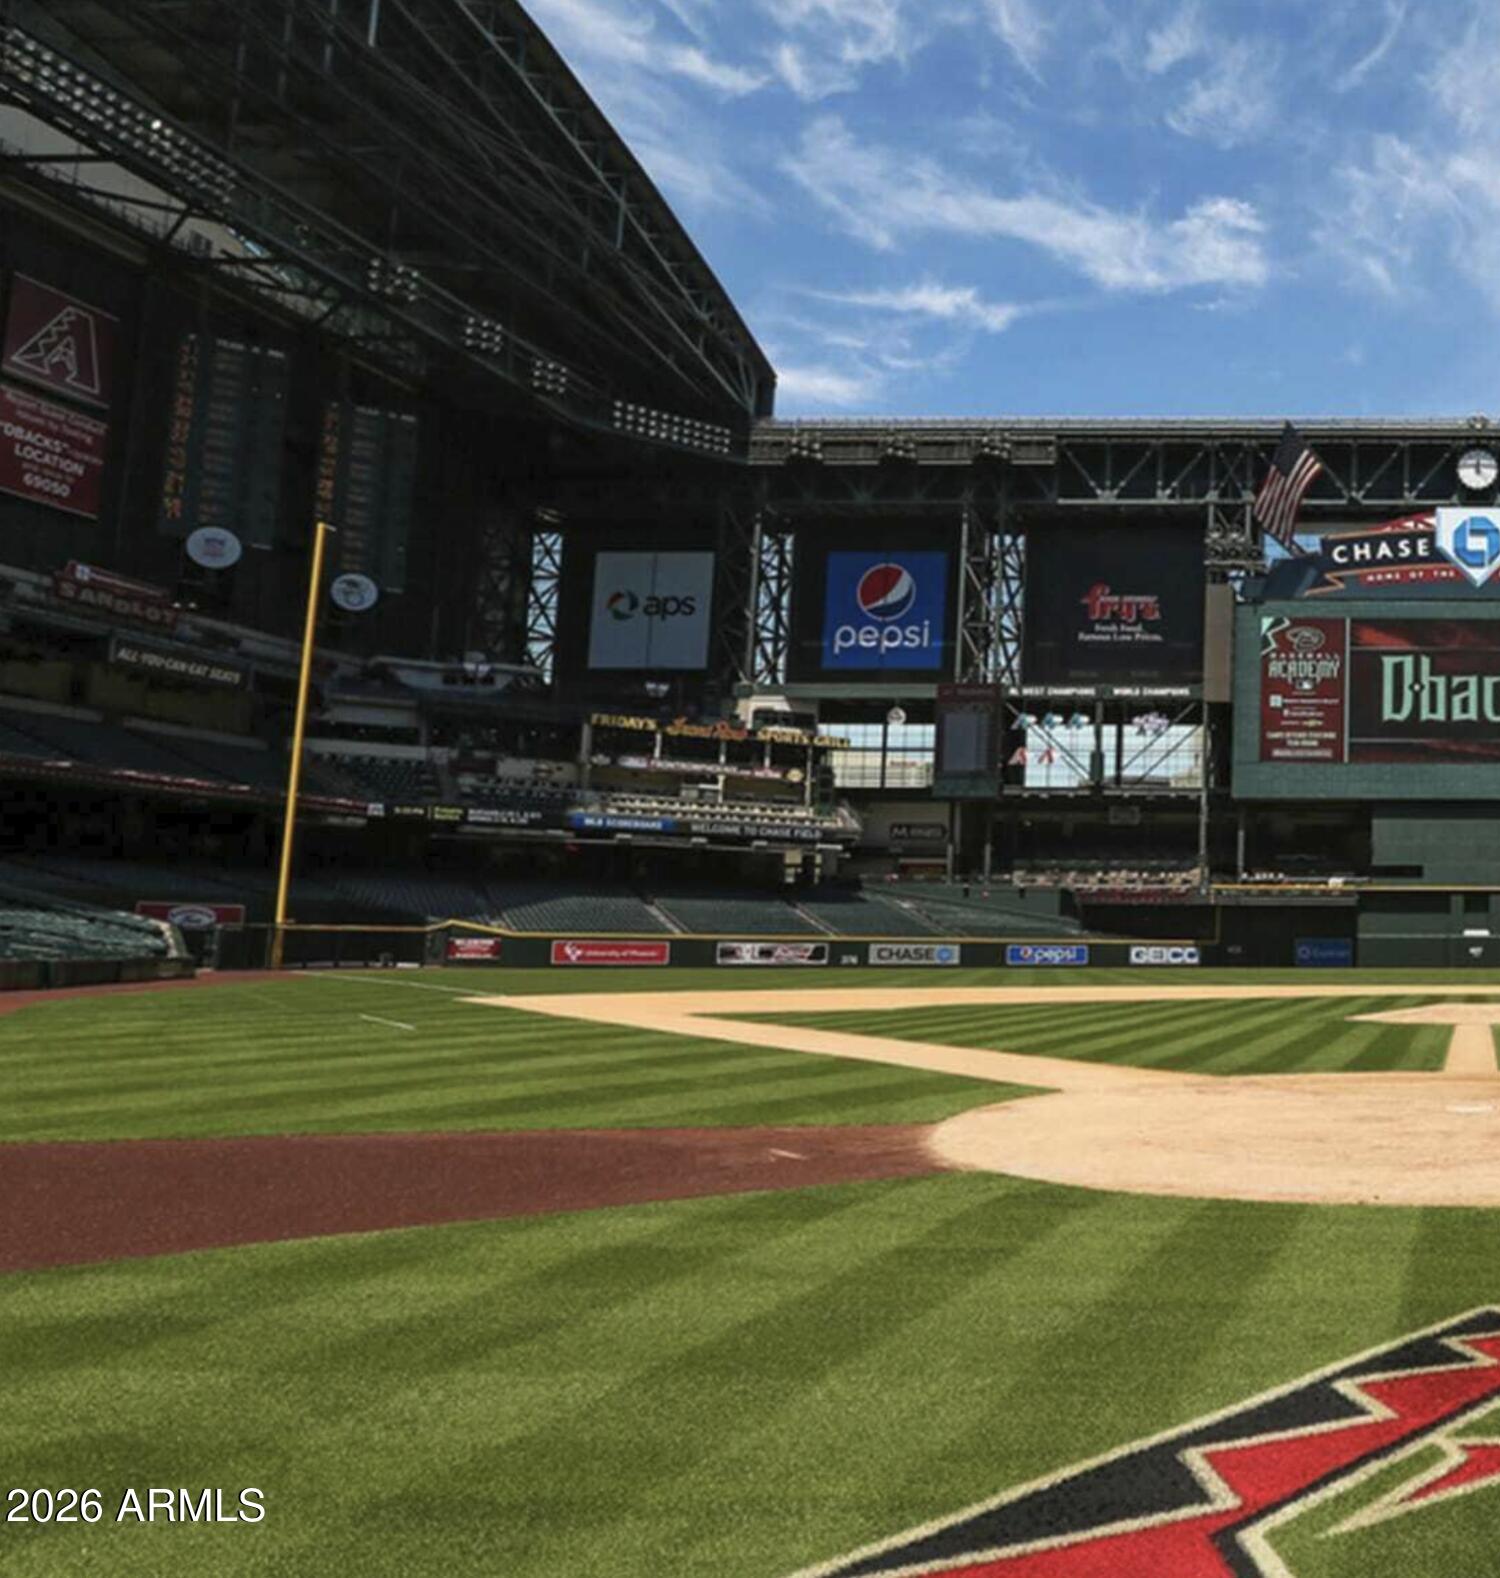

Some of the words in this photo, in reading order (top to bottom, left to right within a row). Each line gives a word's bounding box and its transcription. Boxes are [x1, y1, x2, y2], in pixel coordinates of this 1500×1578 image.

[14, 443, 86, 477] LOCATION
[1331, 538, 1430, 564] CHASE
[1367, 571, 1401, 582] HOME
[1410, 570, 1424, 580] OF
[1433, 569, 1456, 579] THE
[643, 595, 696, 621] aps
[834, 620, 930, 655] pepsi
[1268, 660, 1341, 685] ACADEMY
[691, 823, 741, 836] WELCOME
[744, 825, 757, 836] TO
[759, 826, 791, 838] CHASE
[876, 948, 934, 962] CHASE
[1033, 947, 1077, 964] pepsi
